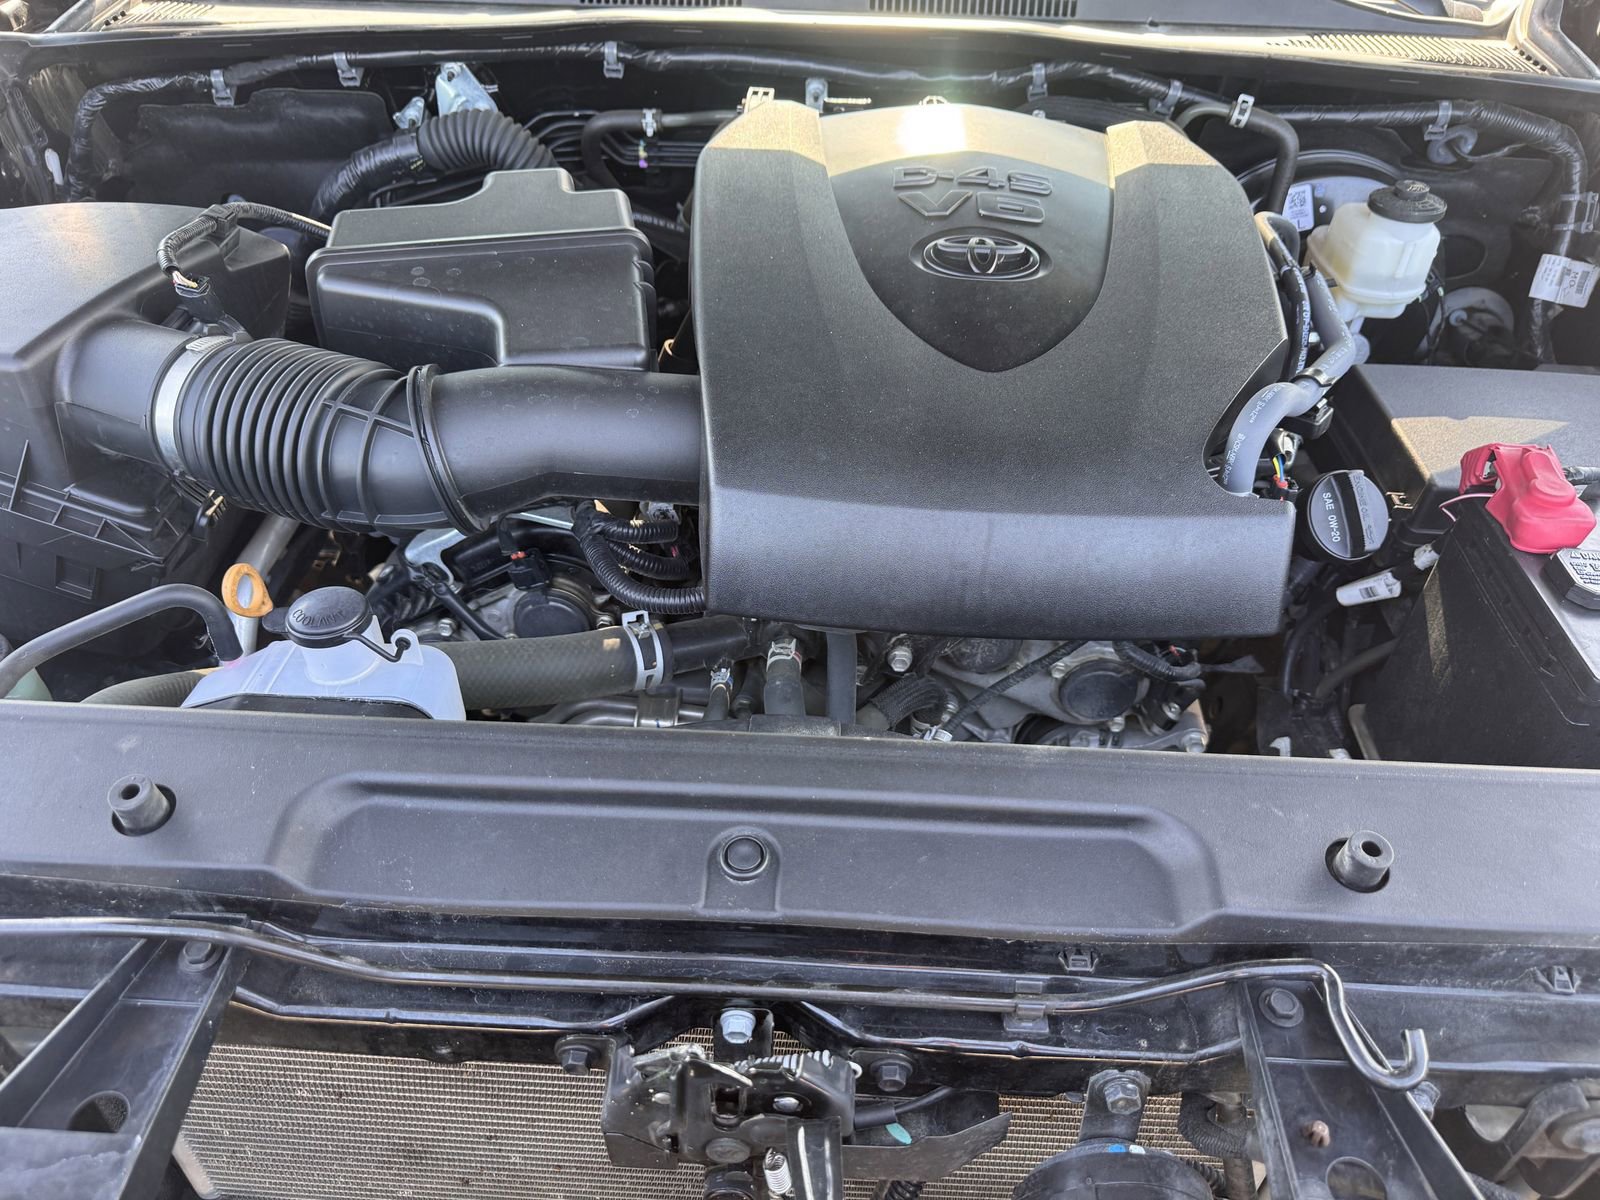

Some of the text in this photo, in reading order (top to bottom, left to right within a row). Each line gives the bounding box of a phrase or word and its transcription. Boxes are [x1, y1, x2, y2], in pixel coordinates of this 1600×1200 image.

[893, 166, 1053, 196] D-4S
[898, 190, 1046, 223] V6
[1322, 492, 1341, 542] SAE 0W-20
[293, 608, 343, 628] COOLANT
